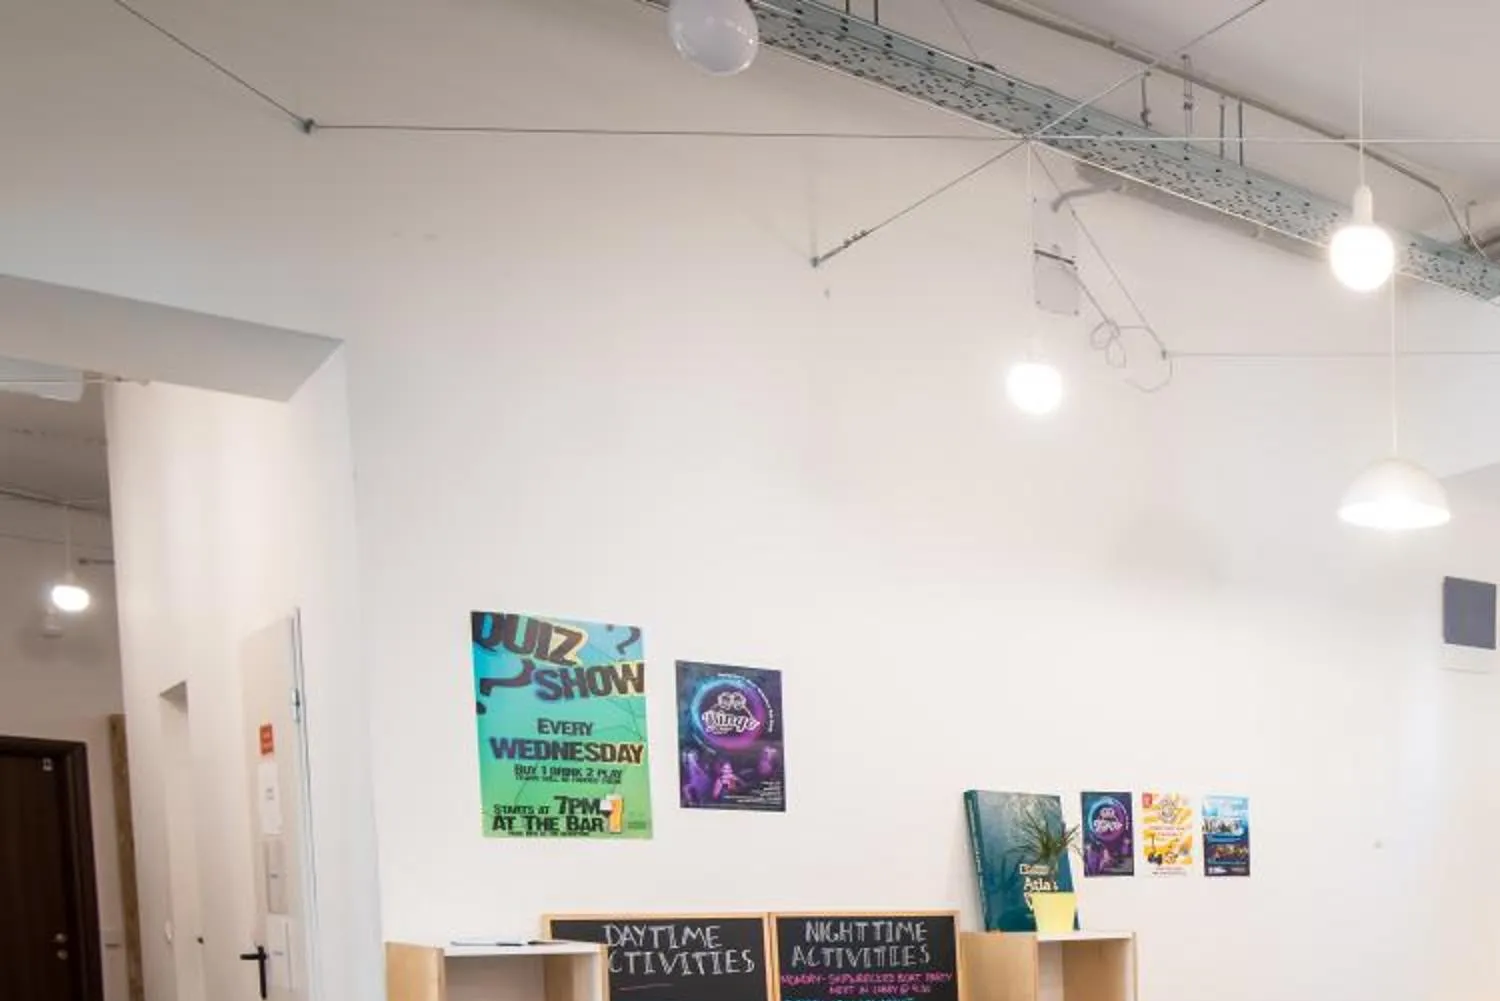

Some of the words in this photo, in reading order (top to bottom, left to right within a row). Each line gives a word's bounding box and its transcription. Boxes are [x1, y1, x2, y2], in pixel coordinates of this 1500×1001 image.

[533, 662, 645, 702] SHOW
[537, 718, 594, 737] EVERY
[489, 736, 644, 765] WEDNESDAY
[514, 764, 537, 777] BUY
[493, 804, 535, 815] STARTS
[554, 796, 601, 816] 7PM
[491, 815, 515, 832] AT
[523, 816, 559, 832] THE
[566, 816, 605, 833] BAR
[602, 924, 723, 949] DAYTIME
[608, 949, 756, 977] CTIVITIES
[791, 943, 931, 969] ACTIVITIES
